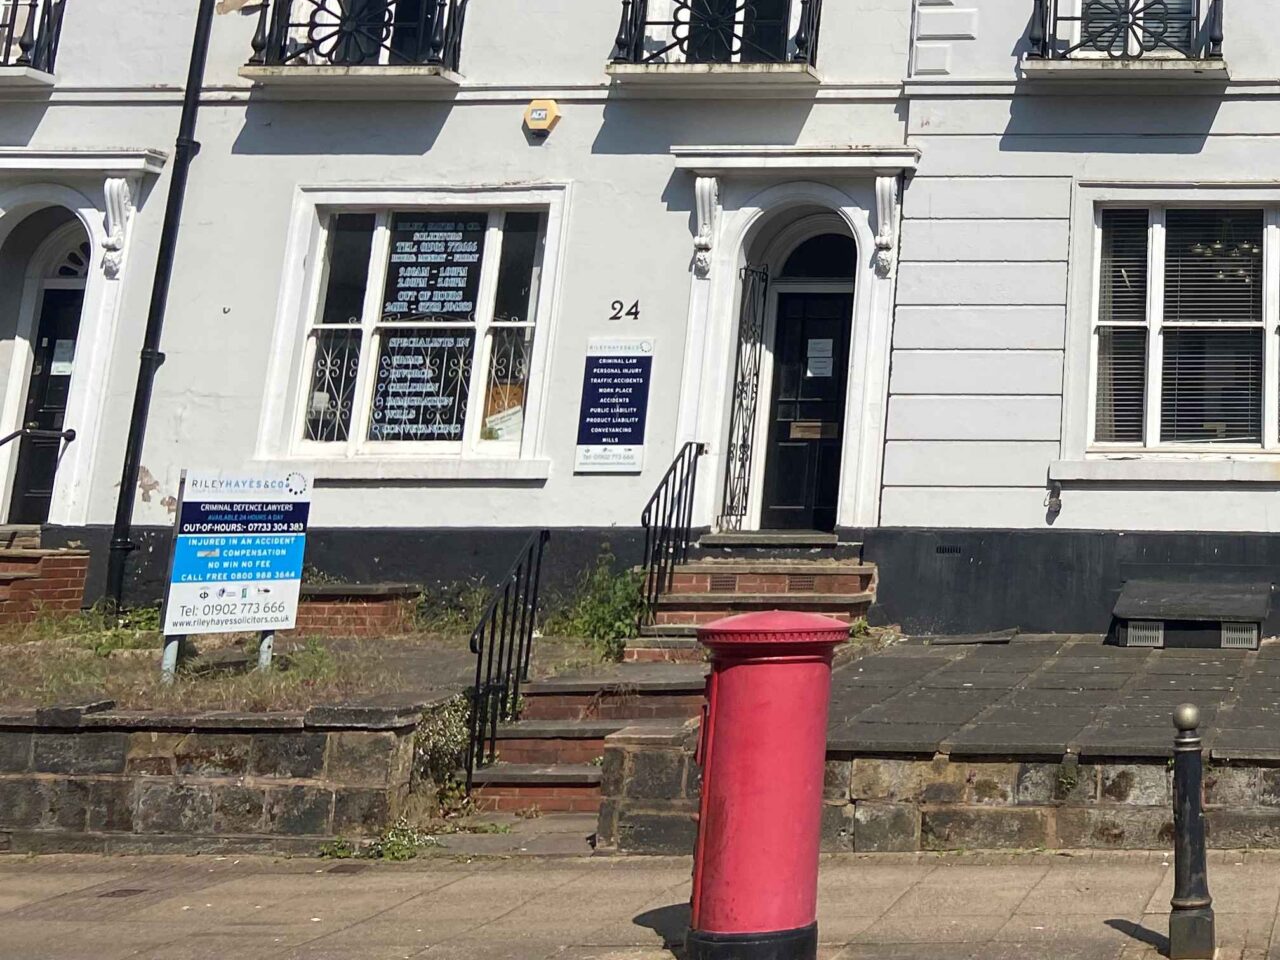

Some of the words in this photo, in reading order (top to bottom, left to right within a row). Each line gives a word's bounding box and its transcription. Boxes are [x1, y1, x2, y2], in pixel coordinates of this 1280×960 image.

[609, 299, 640, 320] 24
[389, 338, 454, 347] SPECIALISTS
[456, 338, 470, 347] IN
[200, 503, 232, 512] CRIMINAL
[233, 503, 263, 512] DEFENCE
[263, 503, 293, 512] LAWYERS
[248, 522, 272, 532] 07733
[273, 522, 288, 531] 304
[290, 522, 304, 531] 383
[188, 537, 226, 546] INJURED
[229, 537, 239, 545] IN
[240, 537, 253, 545] AN
[255, 537, 296, 545] ACCIDENT
[223, 548, 287, 557] COMPENSATION
[208, 561, 221, 569] NO
[255, 560, 271, 568] FEE
[181, 573, 203, 581] CALL
[206, 572, 228, 580] FREE
[230, 572, 253, 580] 0800
[180, 605, 199, 617] Tel:
[202, 604, 237, 616] 01902
[240, 603, 260, 614] 773
[263, 602, 286, 614] 666
[172, 614, 290, 628] www.rileyhayessolicitors.co.uk
